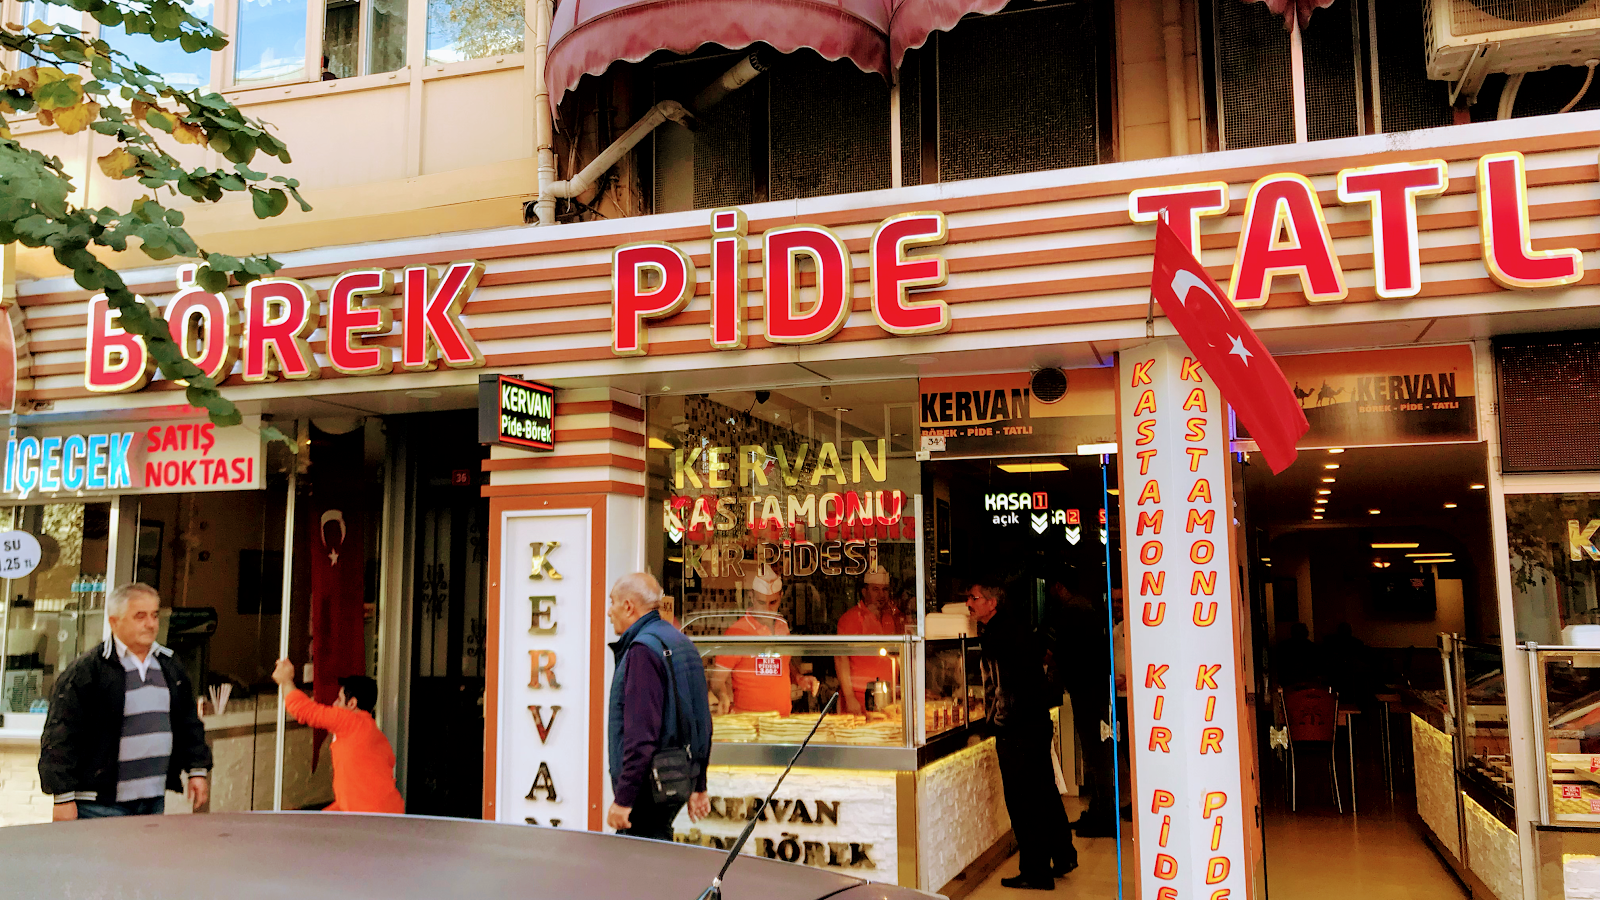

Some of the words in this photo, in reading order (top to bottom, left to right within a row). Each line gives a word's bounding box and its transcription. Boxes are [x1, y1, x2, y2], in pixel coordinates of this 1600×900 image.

[84, 259, 484, 392] BÖREK
[611, 207, 951, 356] PİDE
[502, 384, 551, 419] KERVAN
[1357, 373, 1456, 402] KERVAN
[921, 388, 1030, 423] KERVAN
[1359, 404, 1391, 413] BÖREK
[1400, 402, 1423, 411] PİDE
[1432, 401, 1459, 410] TATLI
[147, 423, 215, 456] SATIŞ
[501, 414, 552, 443] Pide-Börek
[967, 426, 993, 437] PİDE
[1003, 425, 1033, 436] TATLI
[3, 427, 135, 500] İÇECEK
[145, 457, 254, 488] NOKTASI
[456, 473, 467, 483] 36
[674, 438, 887, 490] KERVAN
[984, 492, 1031, 511] KASA
[1131, 358, 1166, 627] KASTAMONU
[1180, 356, 1218, 627] KASTAMONU
[662, 490, 902, 532] KASTAMONU
[992, 512, 1019, 527] açık
[4, 539, 21, 552] SU
[684, 542, 746, 579] KIR
[757, 538, 878, 578] PİDESİ
[24, 559, 35, 568] TL
[524, 541, 563, 827] KERVA
[1145, 663, 1172, 753] KIR
[1195, 663, 1224, 755] KIR
